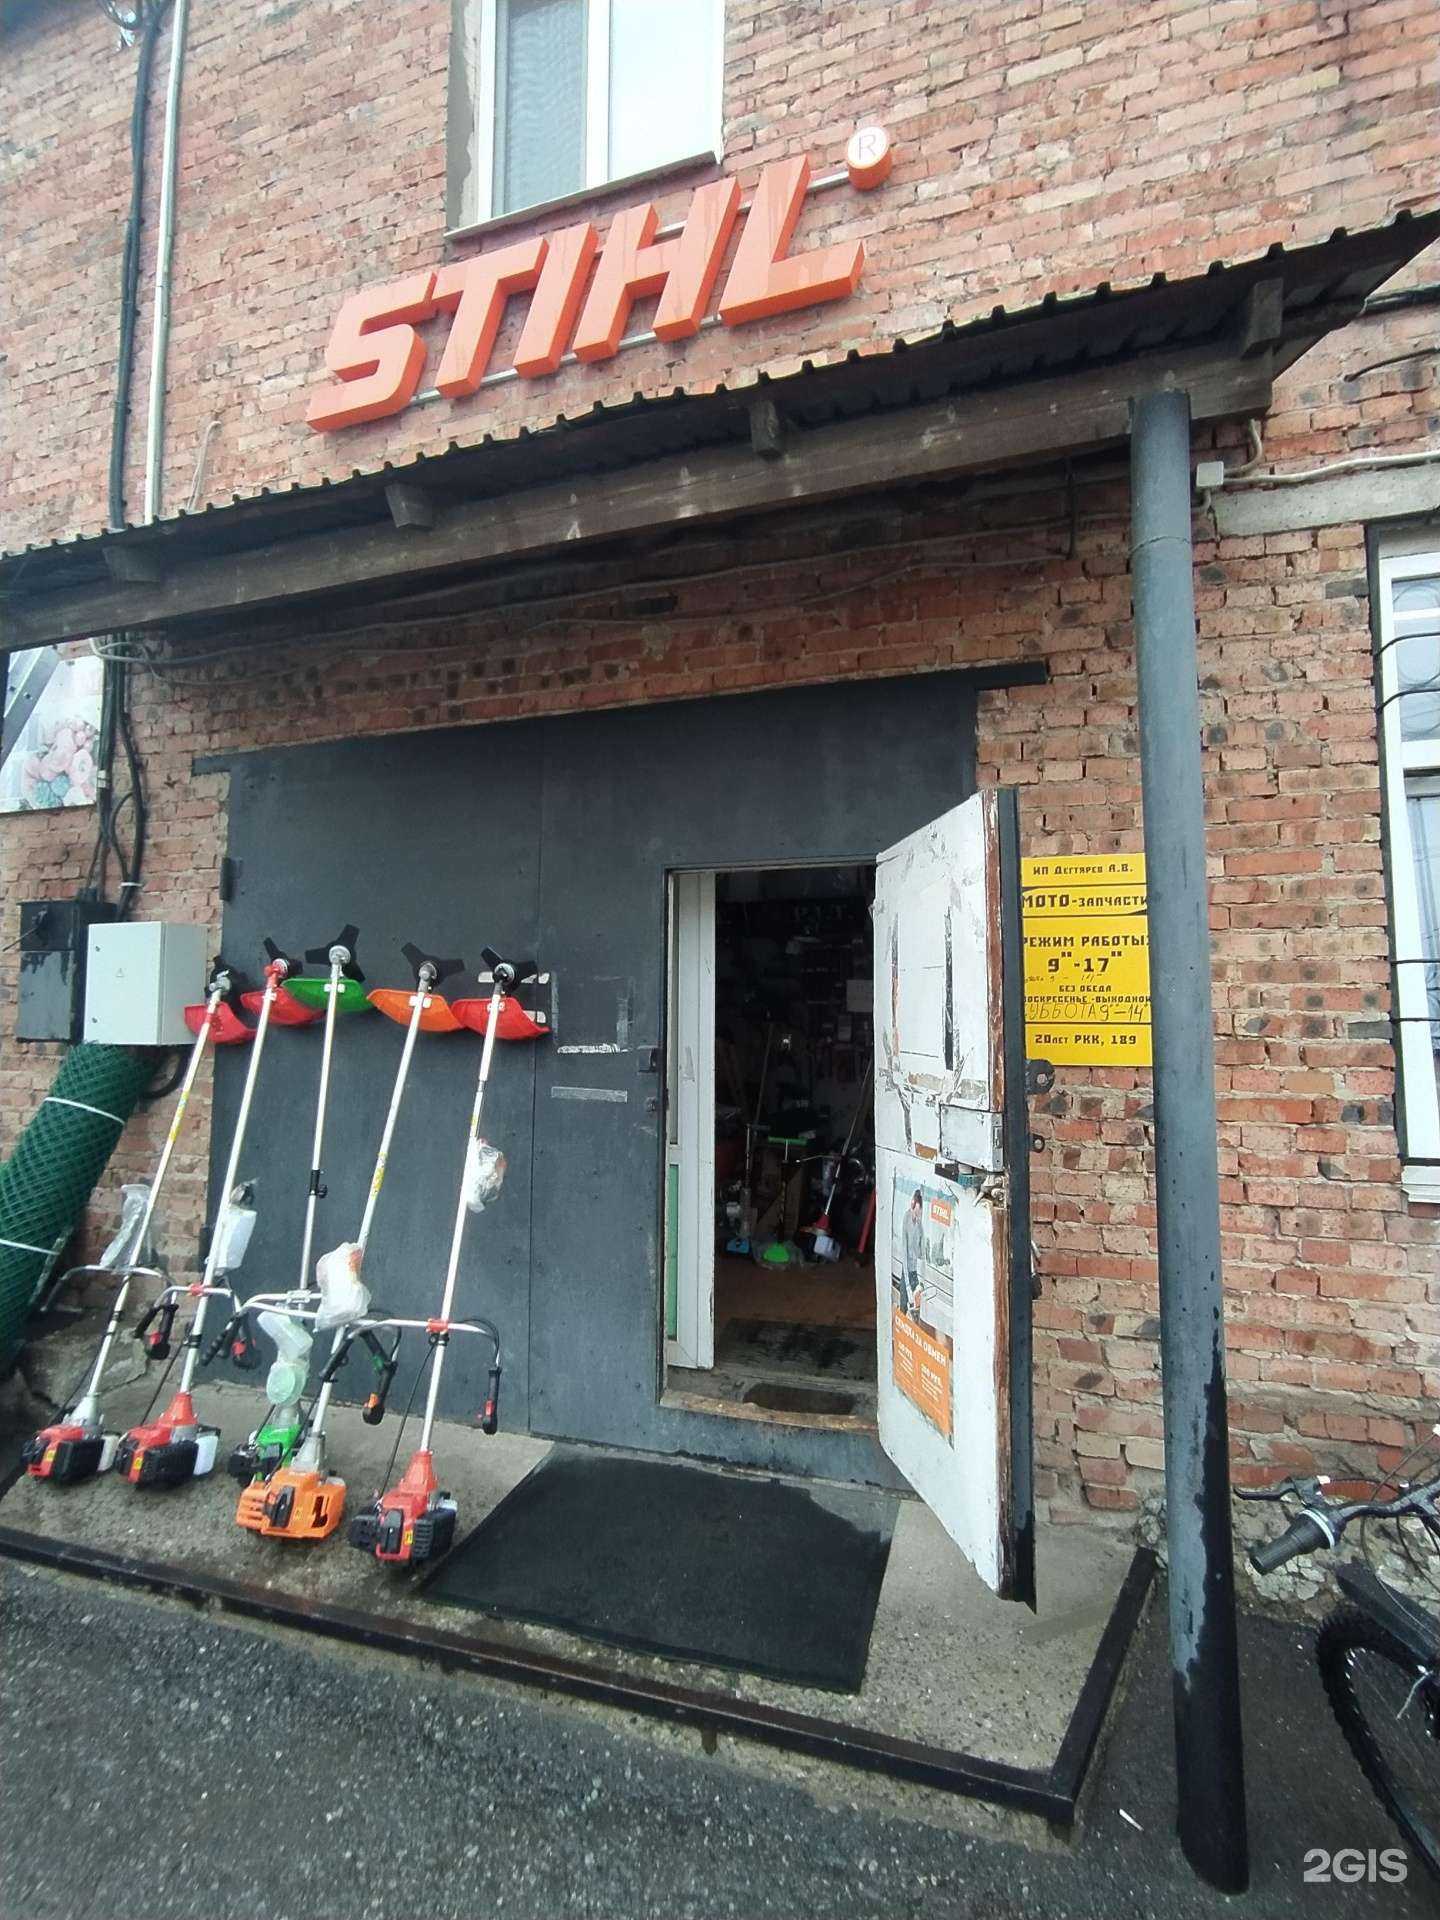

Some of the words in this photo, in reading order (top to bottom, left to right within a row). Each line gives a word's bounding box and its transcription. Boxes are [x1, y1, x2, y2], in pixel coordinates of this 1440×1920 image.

[306, 155, 865, 432] STIHL
[1033, 866, 1049, 875] ИП
[1059, 985, 1076, 993] БЕЗ
[1079, 985, 1112, 993] ОБЕДА
[1111, 1035, 1137, 1045] 189
